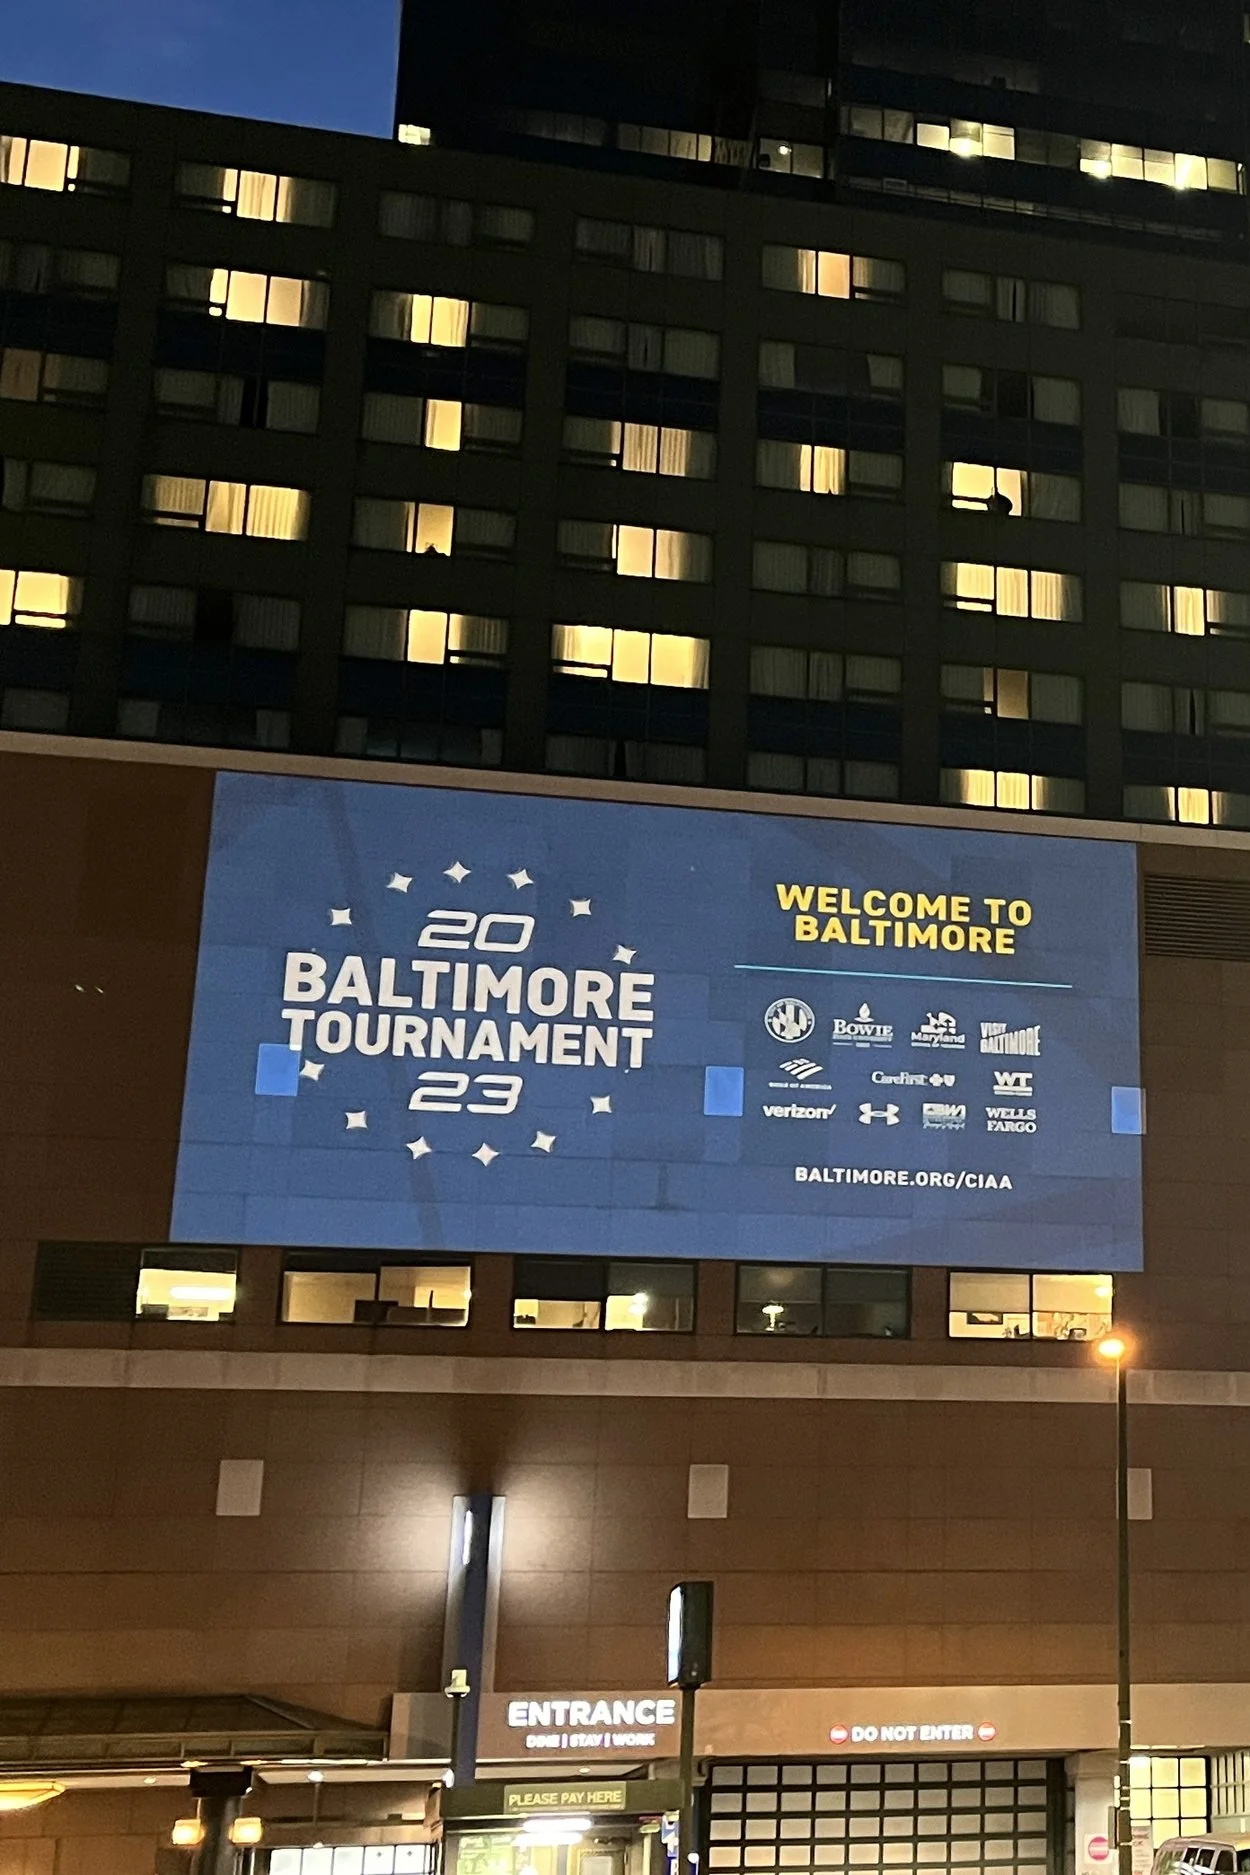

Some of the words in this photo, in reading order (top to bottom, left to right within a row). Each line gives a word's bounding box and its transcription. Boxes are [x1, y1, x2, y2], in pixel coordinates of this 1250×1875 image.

[776, 884, 970, 922] WELCOME
[983, 898, 1032, 927] TO
[417, 909, 536, 953] 20
[795, 915, 1015, 954] BALTIMORE
[283, 952, 654, 1021] BALTIMORE
[281, 1009, 653, 1069] TOURNAMENT
[911, 1032, 965, 1047] Maryland
[408, 1071, 524, 1114] 23
[763, 1103, 829, 1119] verizon
[985, 1107, 1036, 1120] WELLS
[986, 1120, 1037, 1133] FARGO
[795, 1166, 1013, 1190] BALTIMORE.ORG/CIAA
[508, 1699, 676, 1727] ENTRANCE
[851, 1726, 878, 1742] DO
[880, 1725, 918, 1741] NOT
[919, 1724, 974, 1741] ENTER
[508, 1792, 558, 1806] PLEASE
[560, 1792, 584, 1804] PAY
[586, 1790, 622, 1803] HERE
